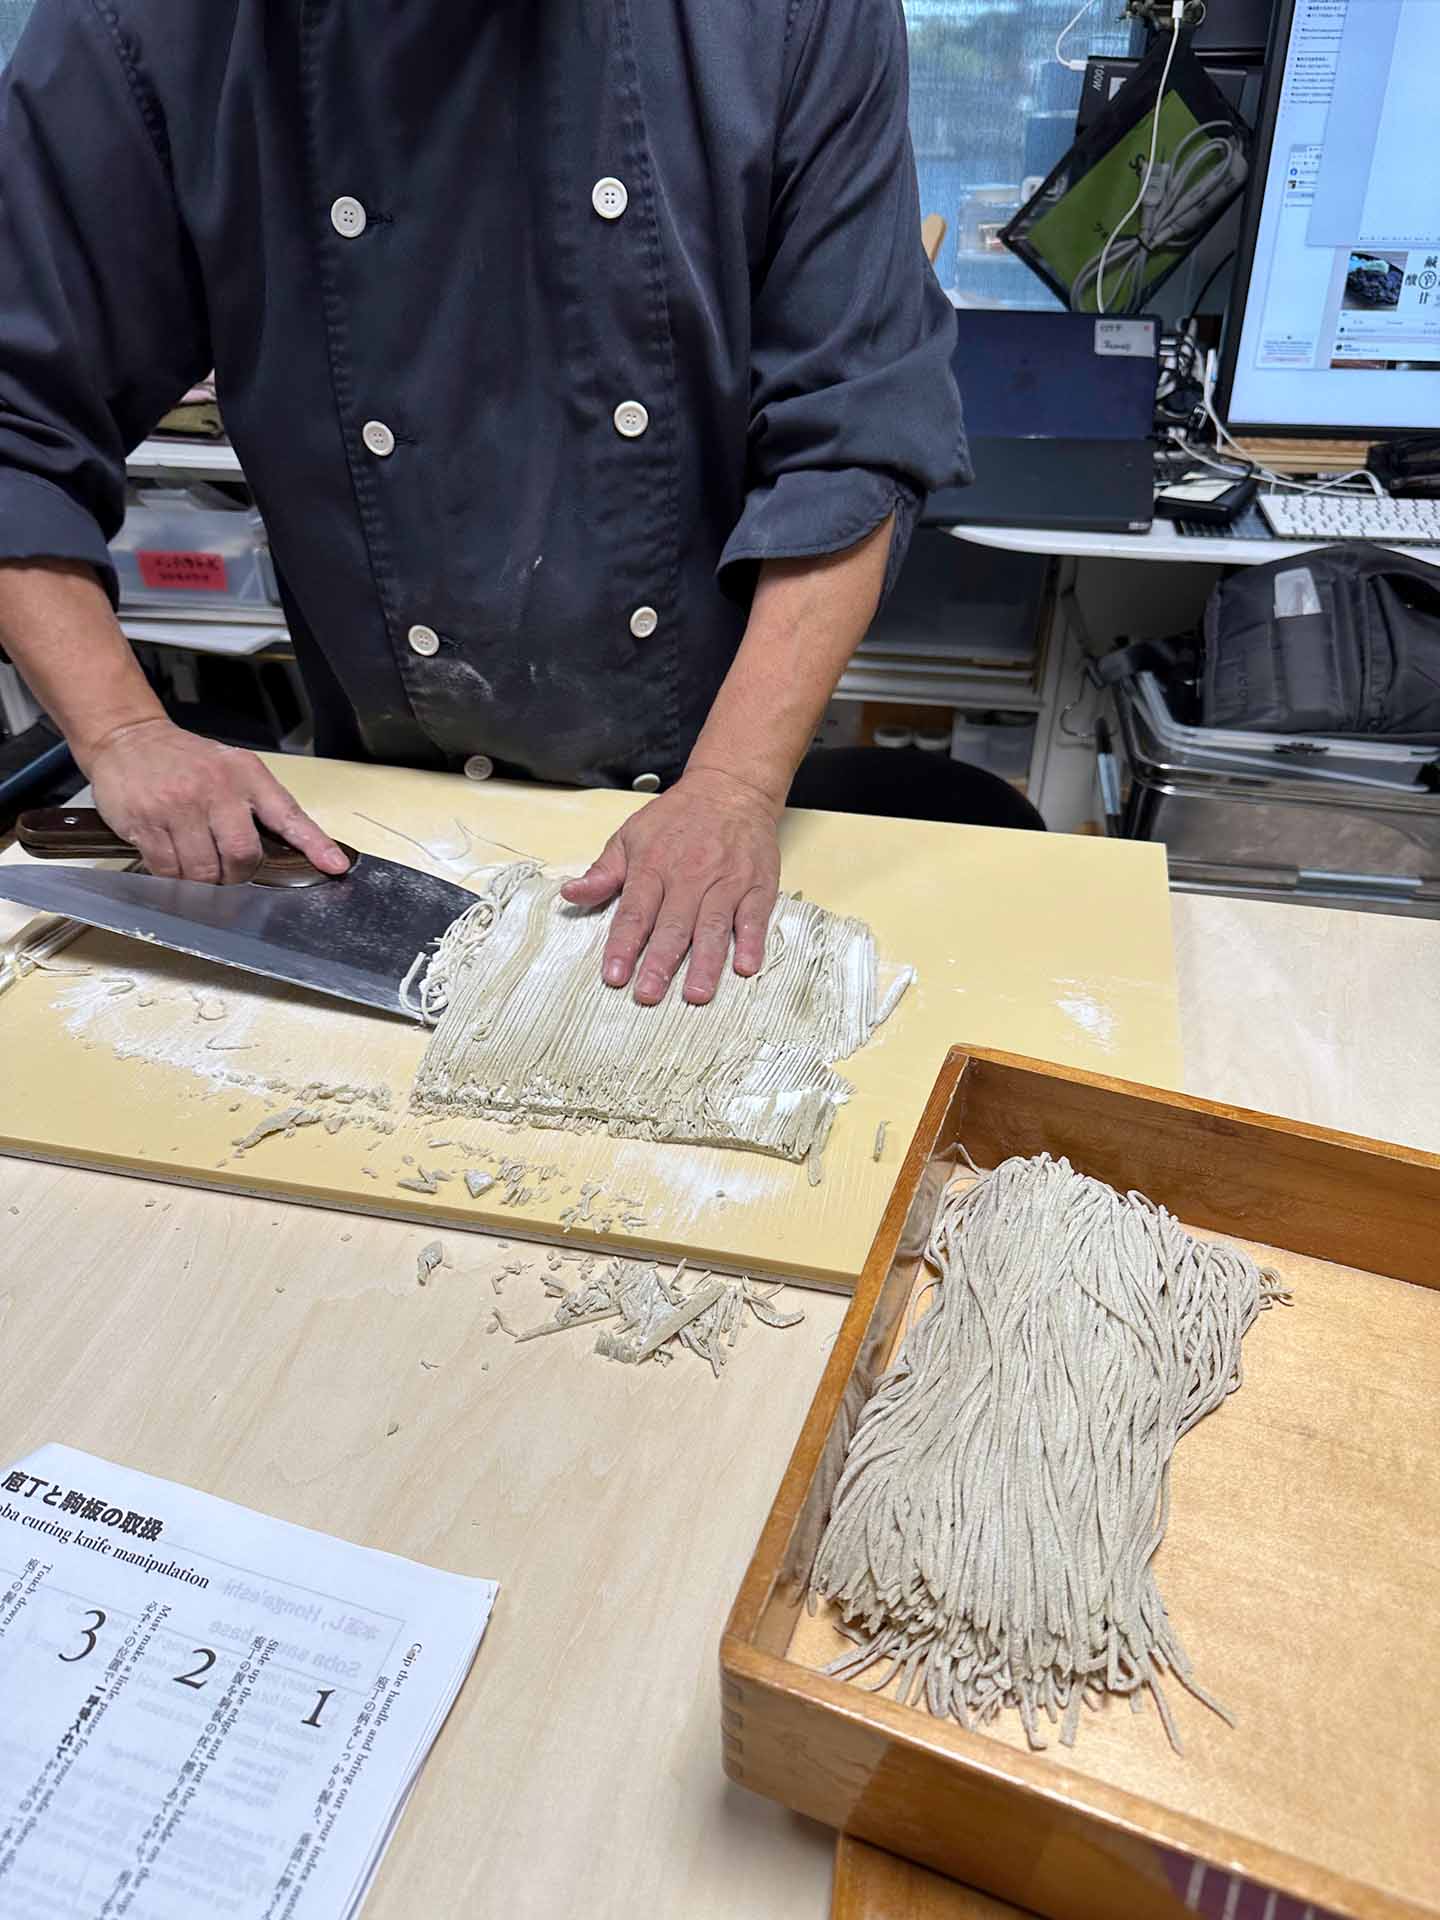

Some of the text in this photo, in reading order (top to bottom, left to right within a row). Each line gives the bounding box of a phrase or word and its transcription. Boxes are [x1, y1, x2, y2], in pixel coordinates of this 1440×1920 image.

[1092, 63, 1105, 92] 100W
[1, 1471, 164, 1542] 庖丁と駒板の取扱
[22, 1515, 72, 1544] cutting
[74, 1531, 112, 1555] knife
[112, 1549, 210, 1590] manipulation
[3, 1564, 54, 1625] Touch down
[150, 1605, 172, 1632] Must
[58, 1610, 106, 1662] 3
[131, 1635, 151, 1663] make
[257, 1639, 279, 1666] Slide
[124, 1665, 132, 1673] a
[172, 1648, 216, 1689] 2
[247, 1668, 260, 1684] up
[394, 1670, 408, 1687] the
[106, 1675, 129, 1701] little
[236, 1687, 252, 1705] the
[84, 1702, 108, 1736] pause
[220, 1708, 239, 1736] edge
[301, 1689, 336, 1728] 1
[374, 1690, 400, 1726] handle
[72, 1738, 88, 1756] for
[206, 1738, 223, 1761] and
[362, 1729, 376, 1752] and
[192, 1762, 208, 1783] put
[343, 1753, 369, 1785] bring
[179, 1786, 196, 1807] the
[333, 1788, 348, 1809] out
[320, 1811, 337, 1842] your
[300, 1846, 326, 1880] index
